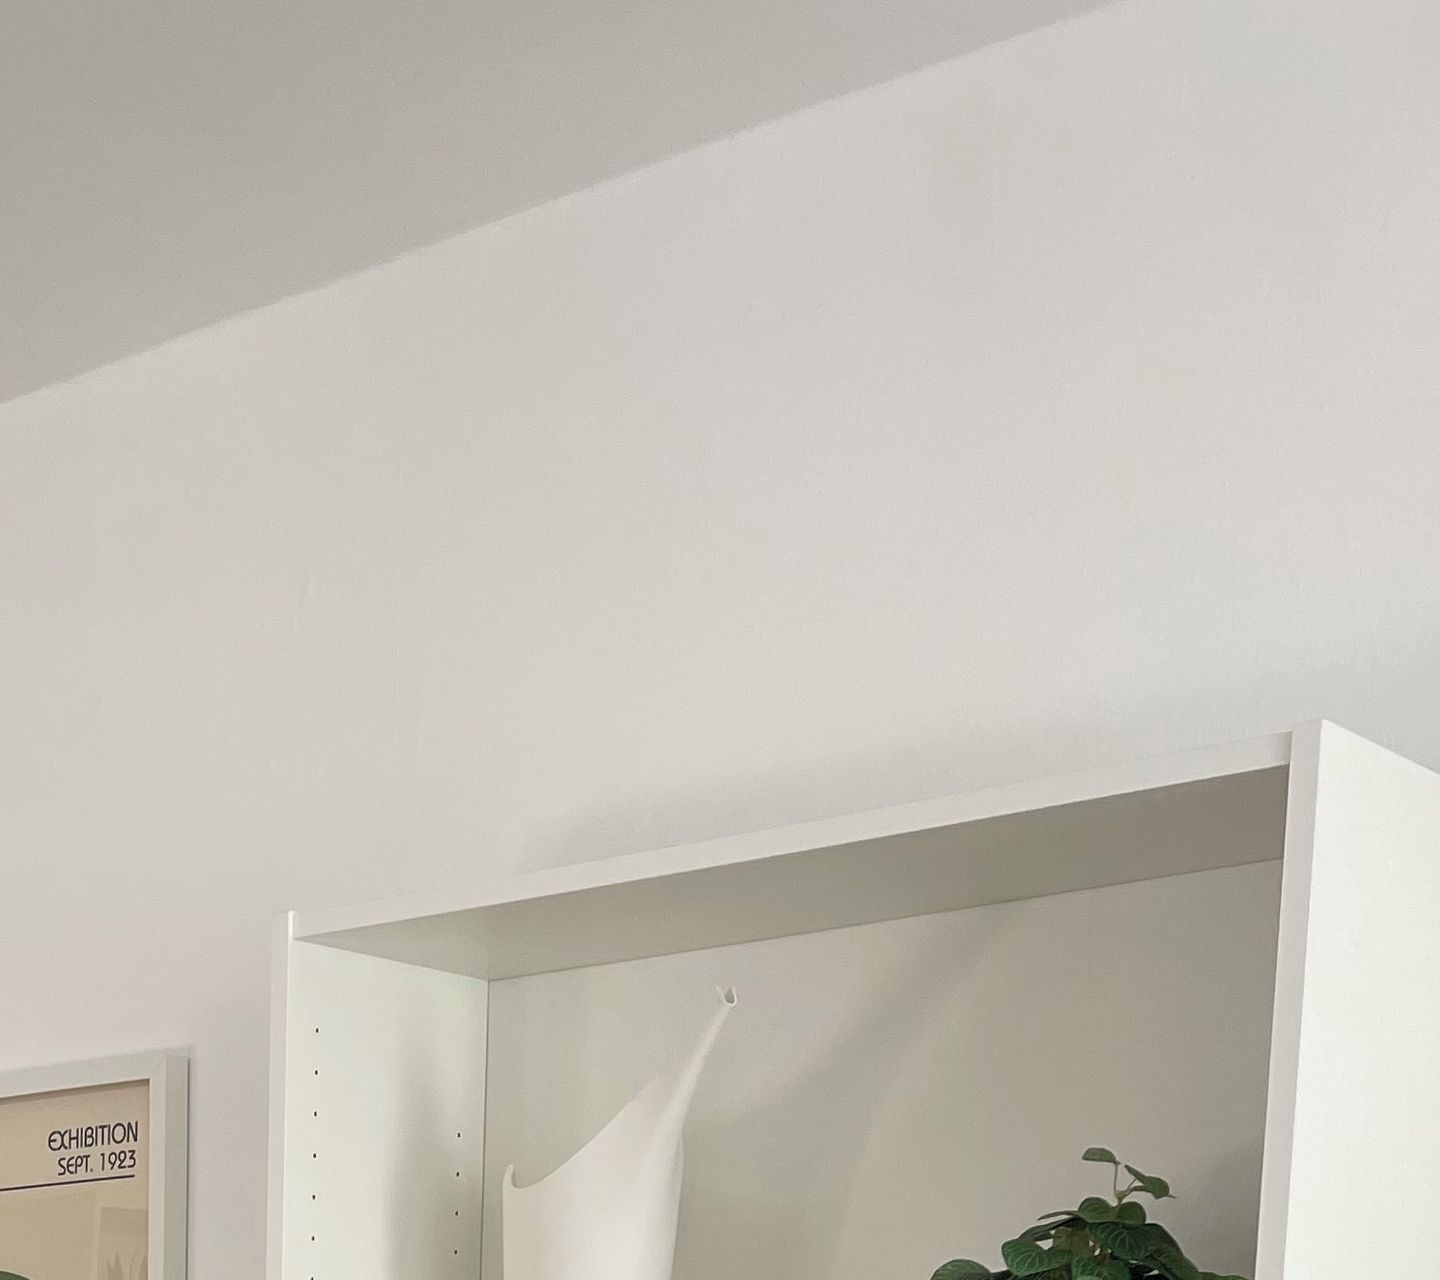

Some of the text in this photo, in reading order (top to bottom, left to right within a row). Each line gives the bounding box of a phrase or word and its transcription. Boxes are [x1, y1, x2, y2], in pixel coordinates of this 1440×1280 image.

[48, 1121, 138, 1152] EXHIBITION
[57, 1150, 137, 1177] SEPT. 1923
